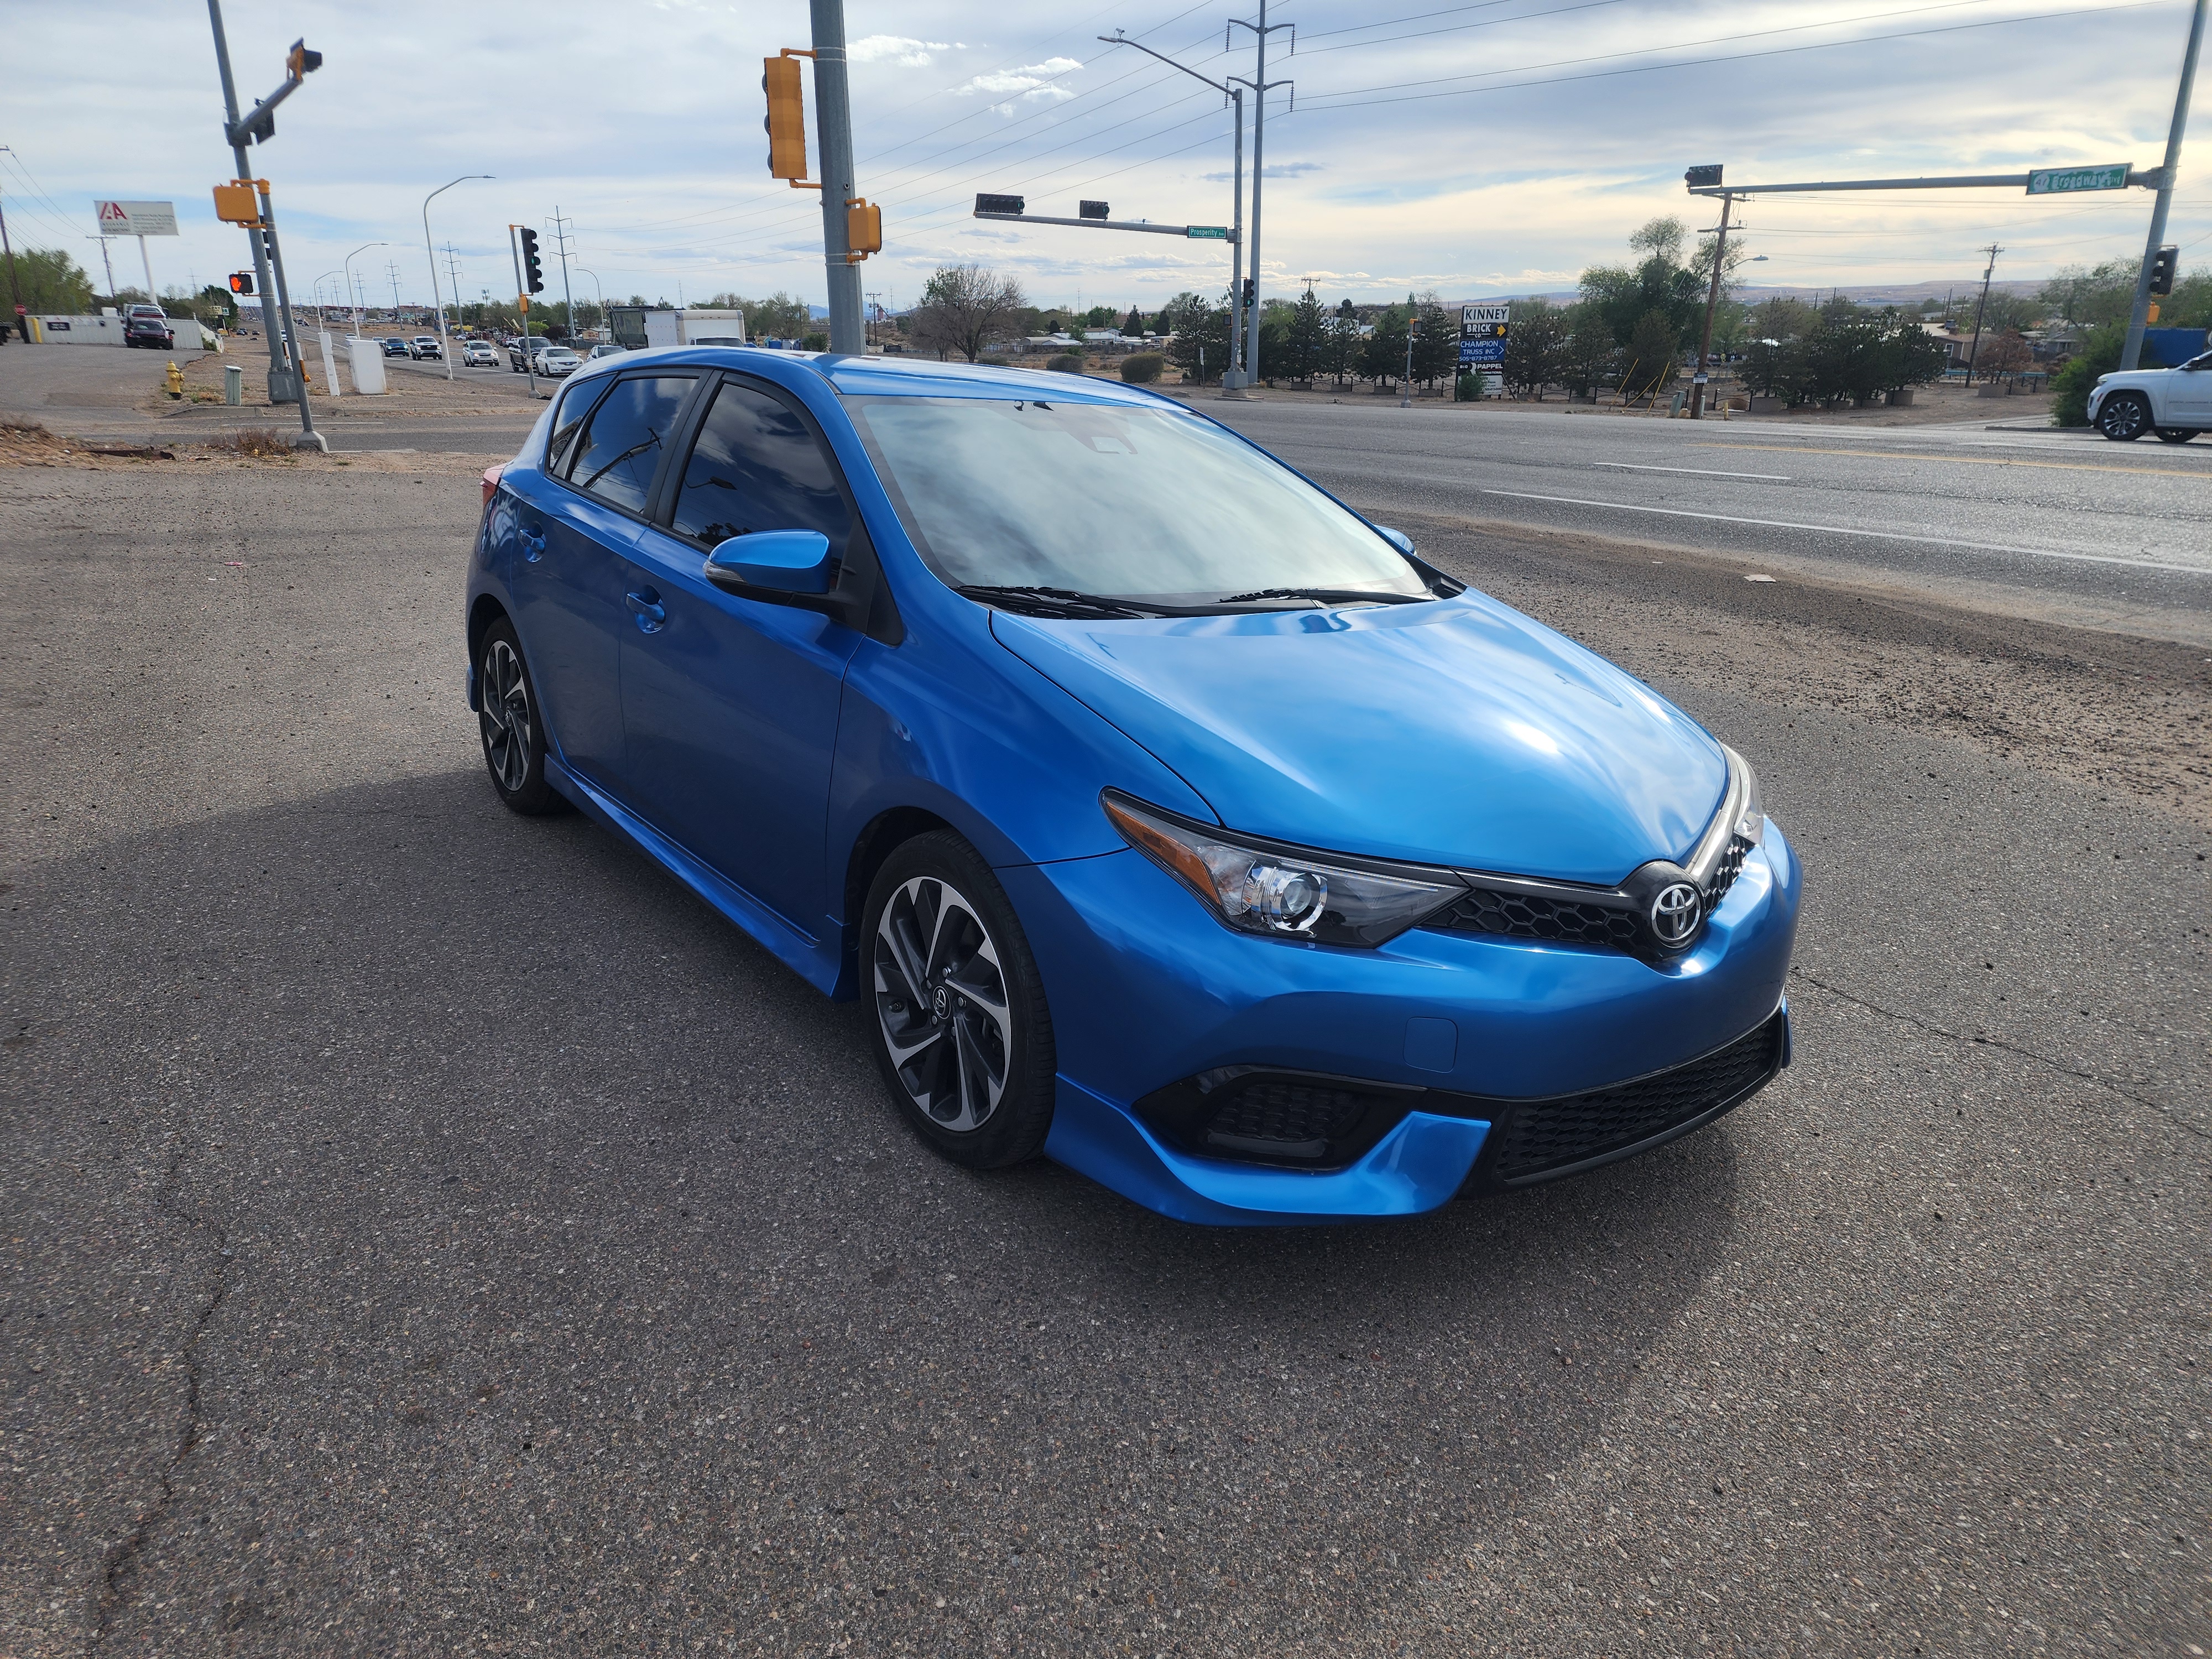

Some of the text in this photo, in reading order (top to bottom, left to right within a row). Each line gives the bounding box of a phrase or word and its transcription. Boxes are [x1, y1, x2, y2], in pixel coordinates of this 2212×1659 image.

[1190, 228, 1218, 237] Prosperity
[1465, 309, 1507, 320] KINNEY
[1467, 324, 1491, 333] BRICK
[1460, 340, 1499, 348] CHAMPION
